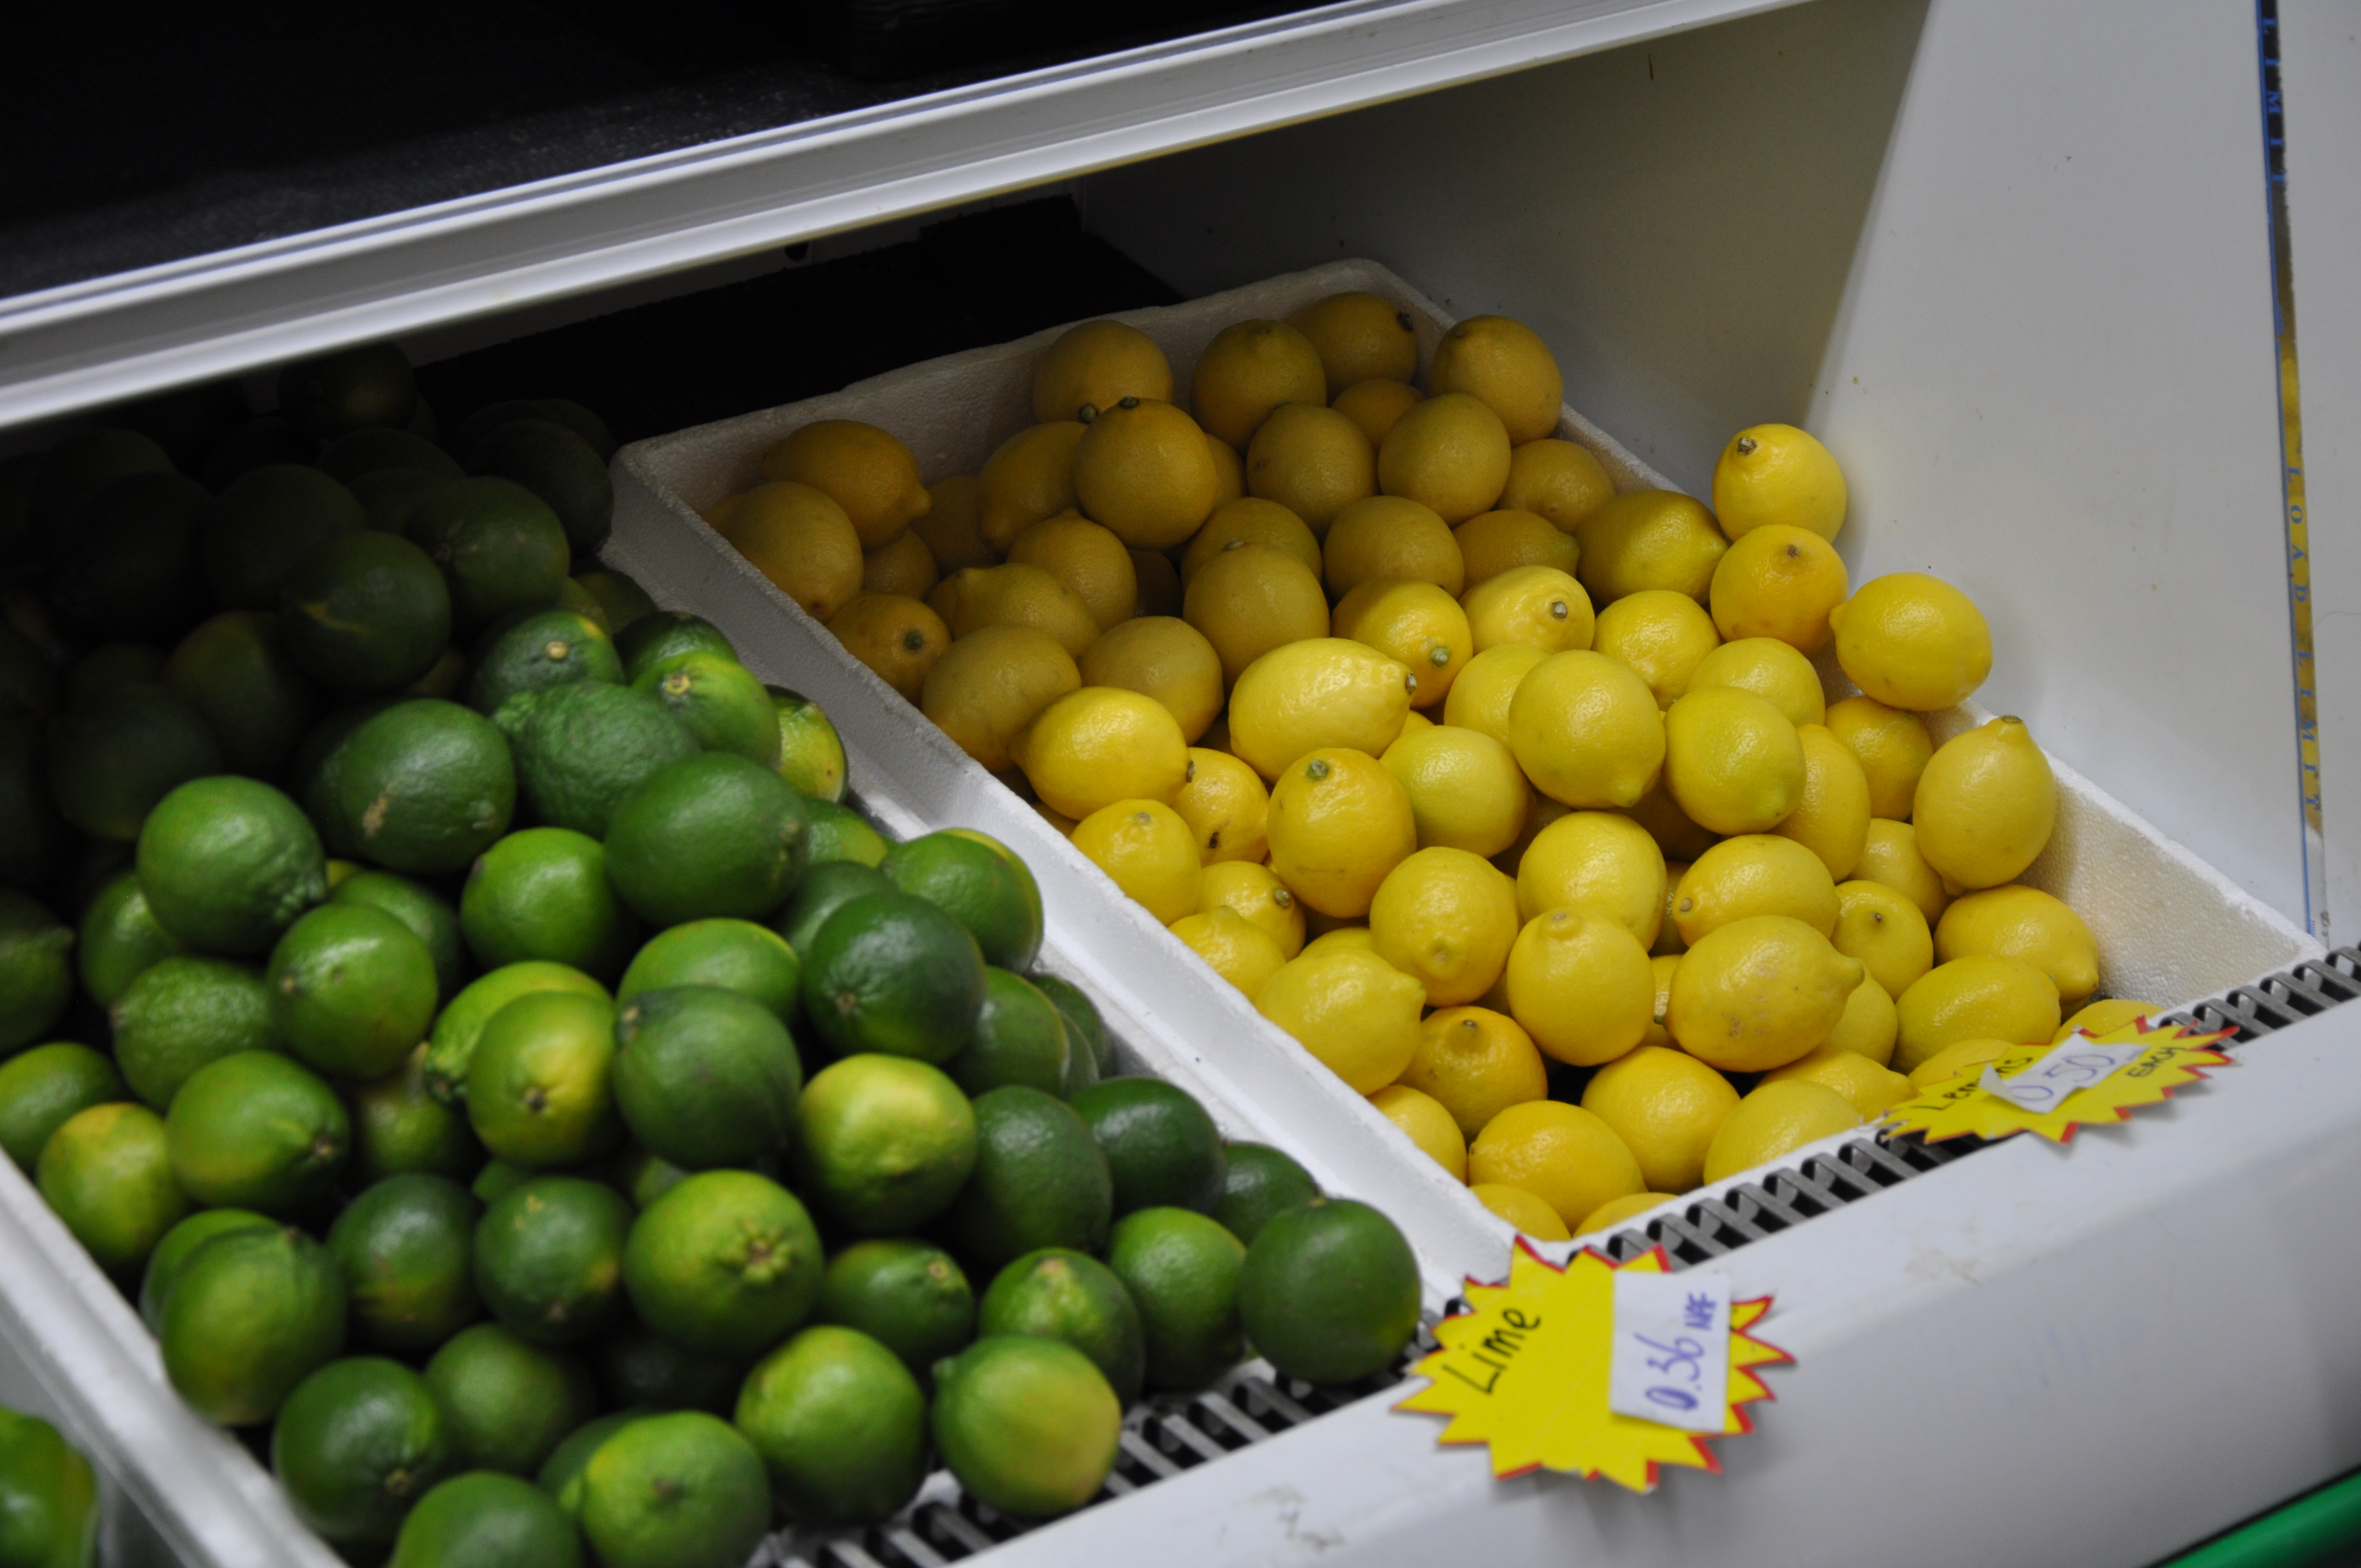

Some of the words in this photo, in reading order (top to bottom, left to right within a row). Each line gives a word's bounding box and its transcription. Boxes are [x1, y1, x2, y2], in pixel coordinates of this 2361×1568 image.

[2262, 18, 2285, 187] LIMIT
[2287, 466, 2308, 602] LOAD
[2298, 651, 2320, 810] LIMIT
[1910, 1057, 2033, 1110] Lemns
[1441, 1308, 1541, 1395] Lime
